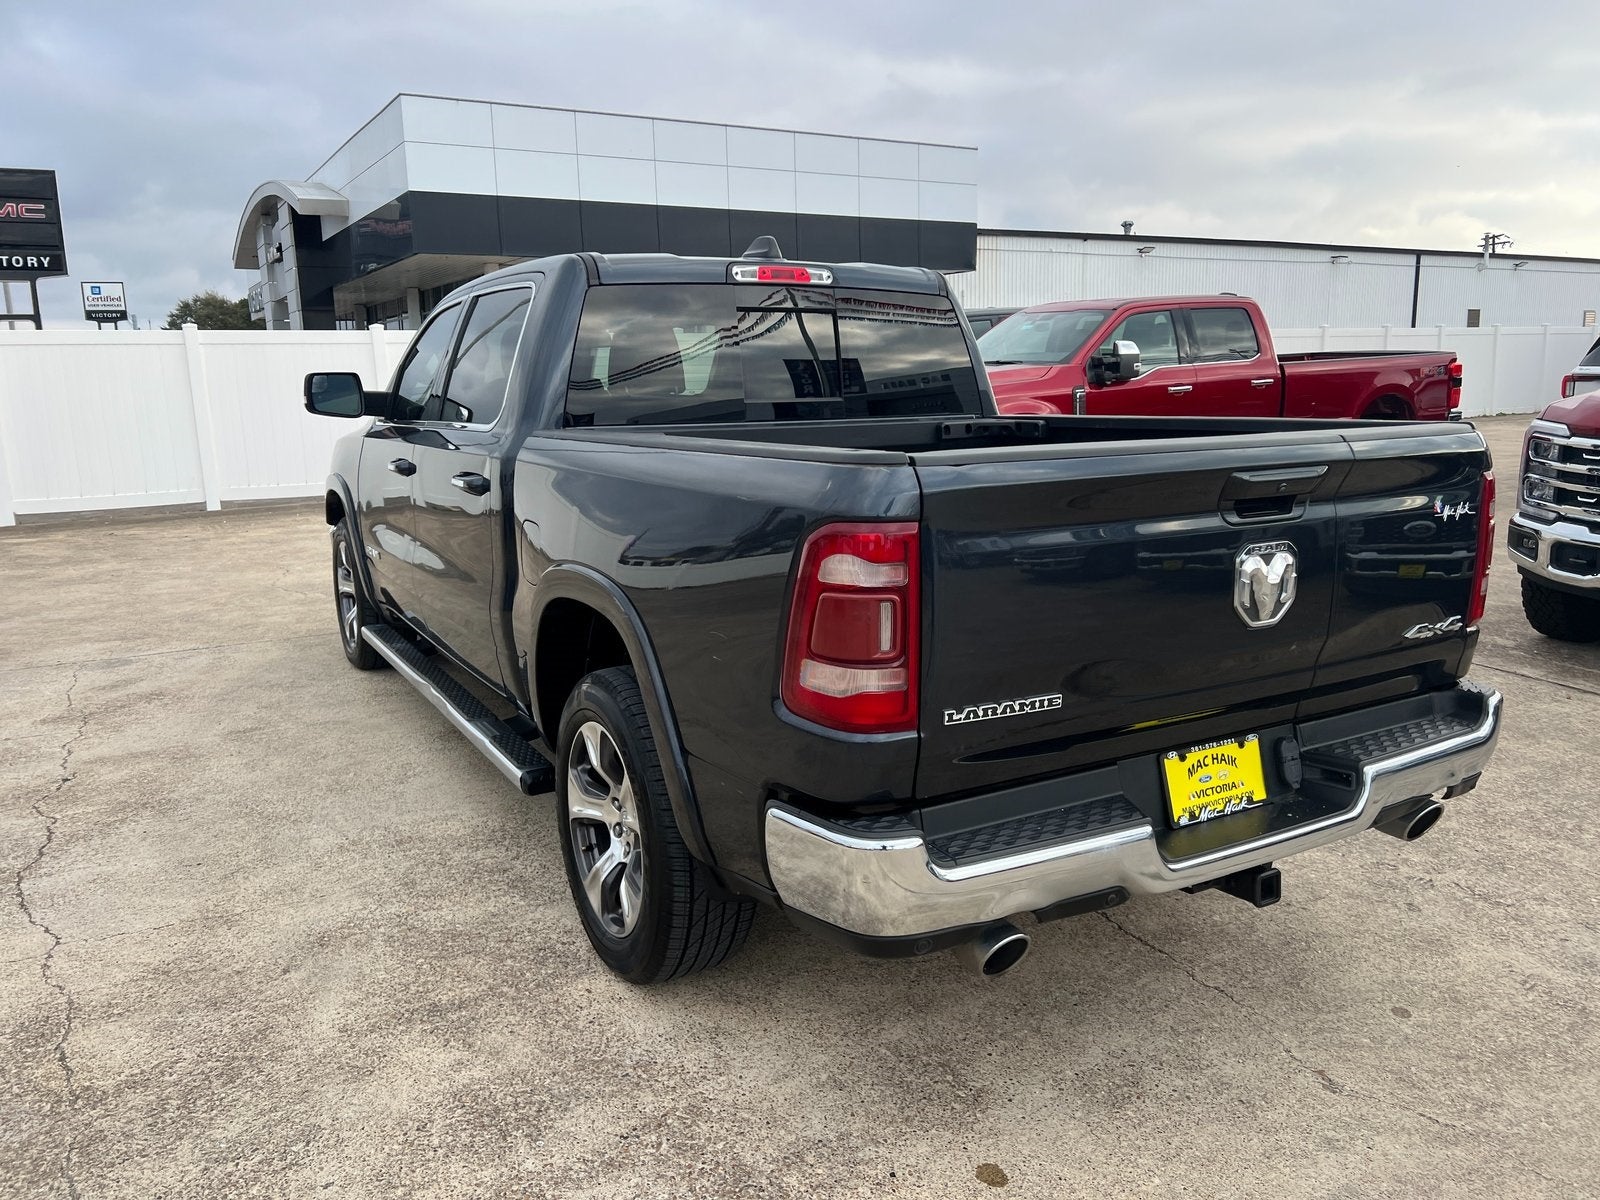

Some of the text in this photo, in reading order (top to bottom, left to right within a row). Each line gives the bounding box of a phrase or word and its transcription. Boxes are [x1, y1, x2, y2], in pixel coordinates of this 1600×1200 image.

[1250, 543, 1288, 554] RAM
[944, 693, 1063, 725] LARAMIE
[1187, 753, 1238, 780] MAC HAIK
[1195, 781, 1237, 799] VICTORIA
[1196, 797, 1255, 822] Mac Haik
